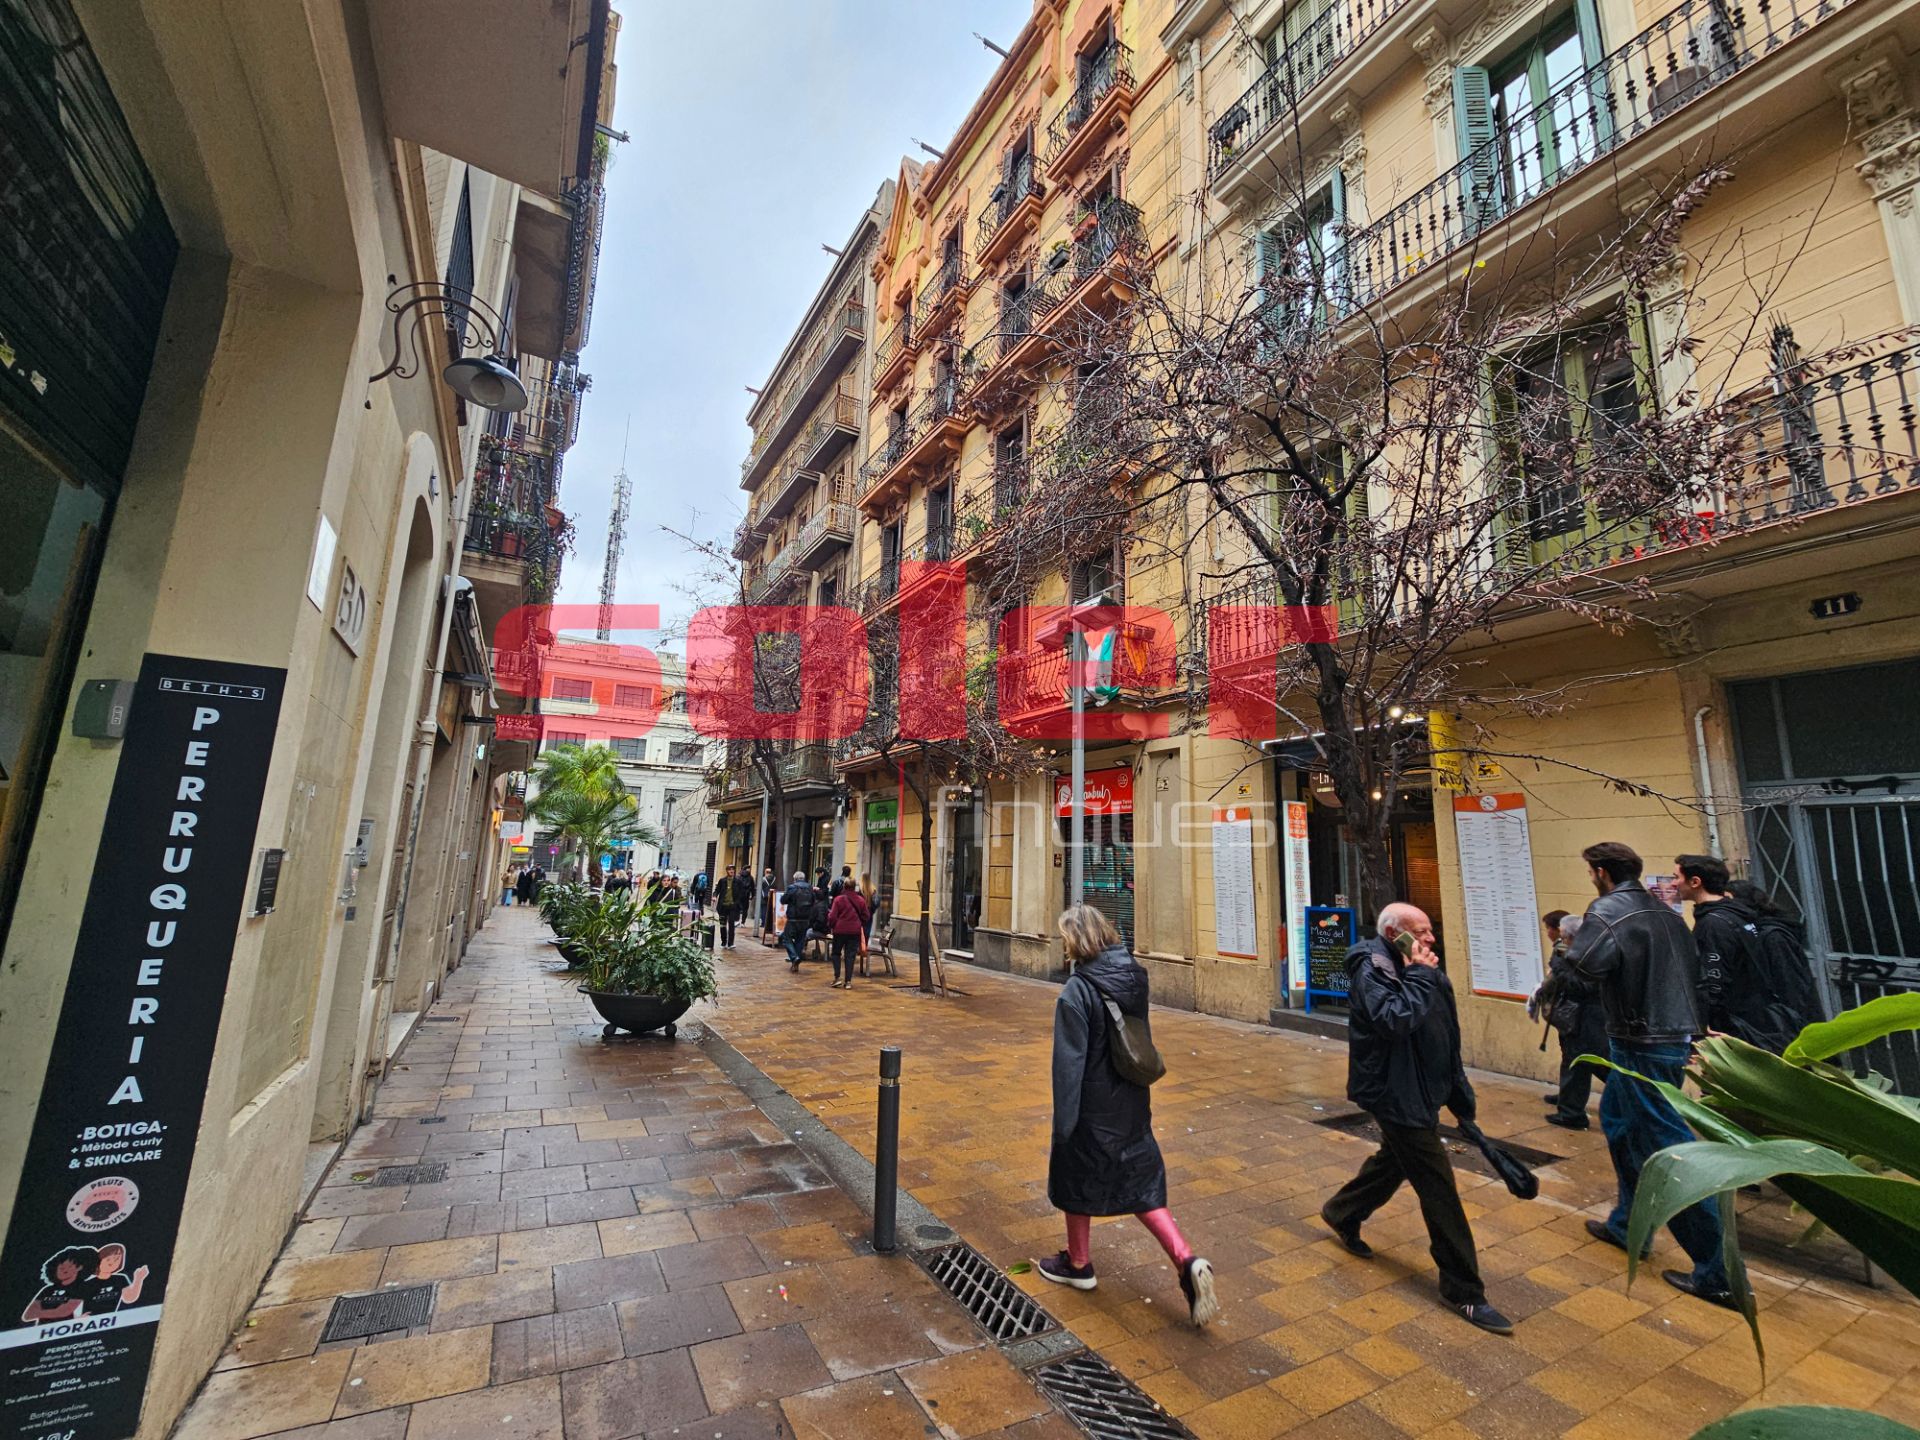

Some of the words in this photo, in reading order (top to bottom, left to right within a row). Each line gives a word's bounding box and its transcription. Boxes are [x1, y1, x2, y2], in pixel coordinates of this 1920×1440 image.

[1823, 597, 1848, 615] 11
[108, 706, 220, 1105] PERRUQUERIA
[80, 1140, 129, 1152] Mètode
[132, 1137, 162, 1147] curly
[68, 1158, 80, 1169] &
[84, 1150, 162, 1168] SKINCARE
[90, 1179, 124, 1190] PELUTS
[73, 1212, 127, 1230] BENVINGUTS
[40, 1316, 117, 1339] HORARI
[50, 1378, 81, 1388] BOTIGA
[30, 1410, 59, 1420] Botiga
